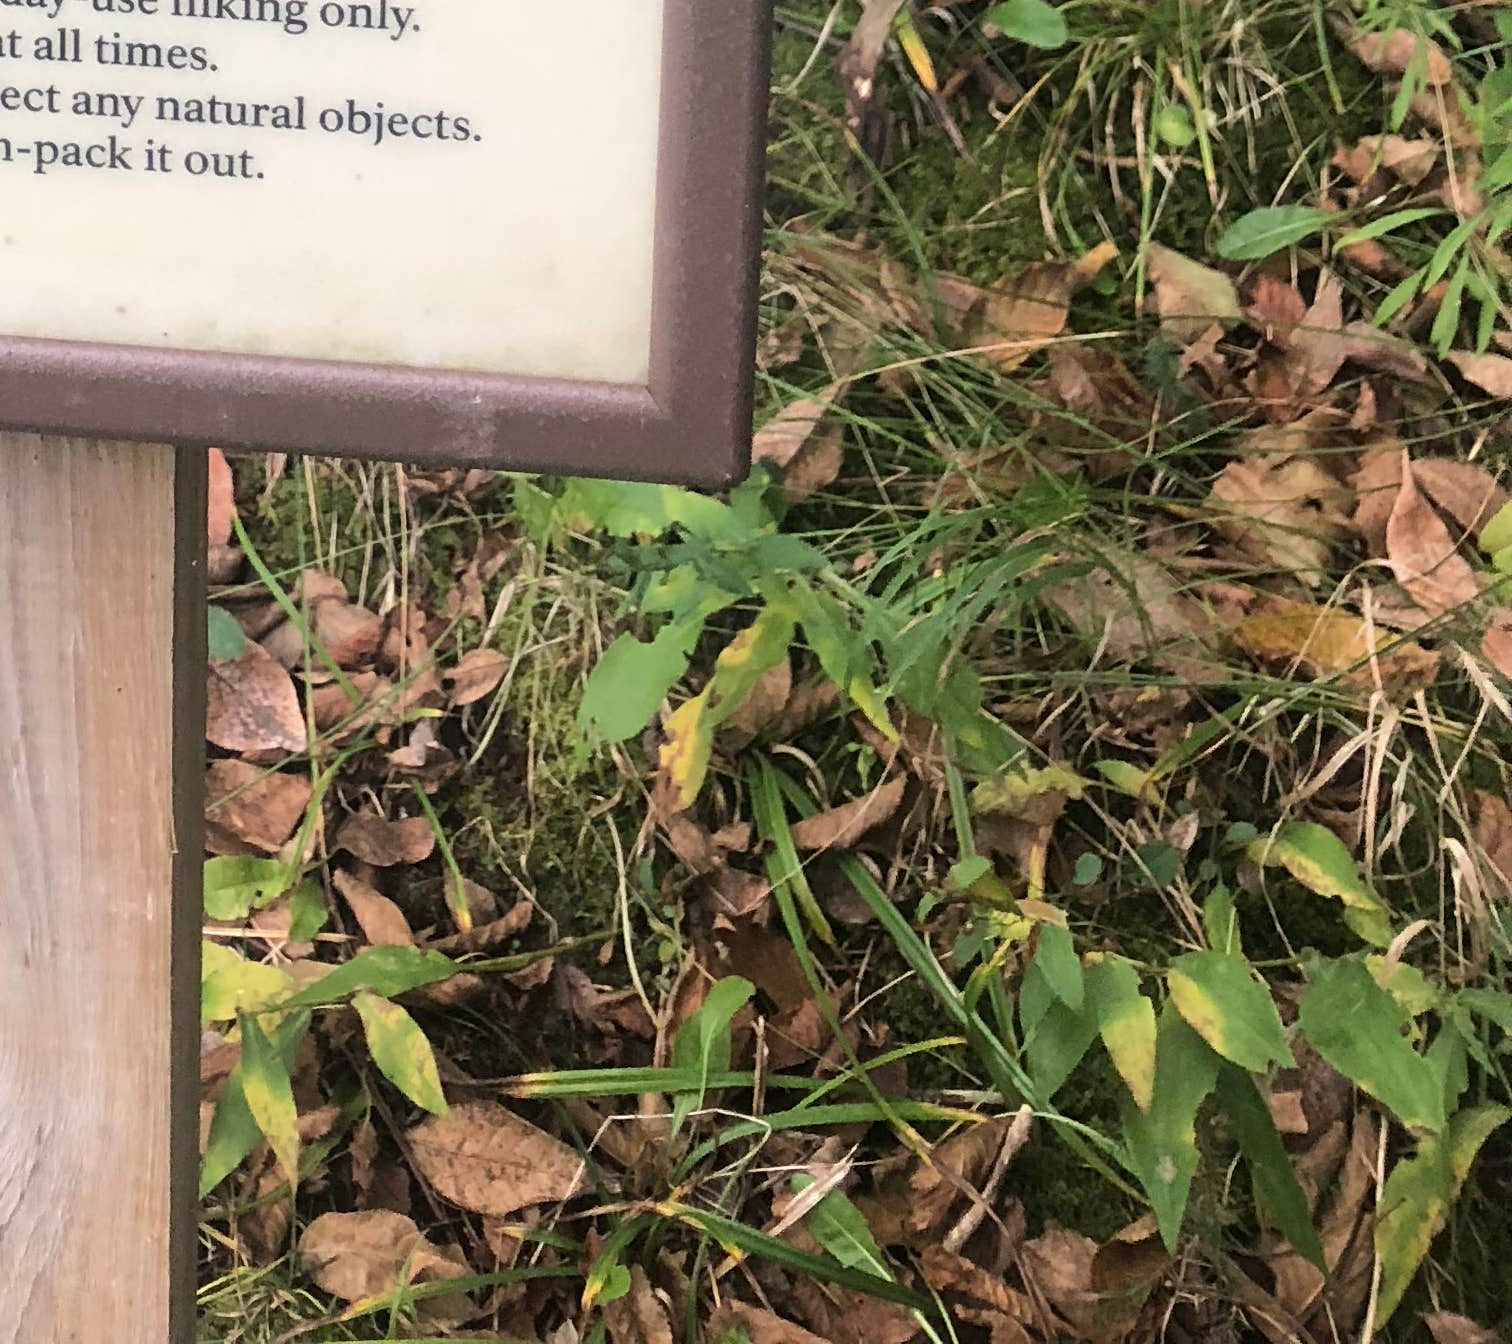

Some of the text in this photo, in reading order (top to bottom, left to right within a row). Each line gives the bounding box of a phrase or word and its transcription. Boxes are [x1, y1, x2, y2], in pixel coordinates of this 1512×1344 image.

[34, 28, 82, 62] all
[95, 32, 217, 71] times.
[72, 92, 144, 128] any
[156, 96, 306, 130] natural
[319, 99, 481, 145] objects.
[144, 139, 172, 172] it
[185, 150, 264, 179] out.
